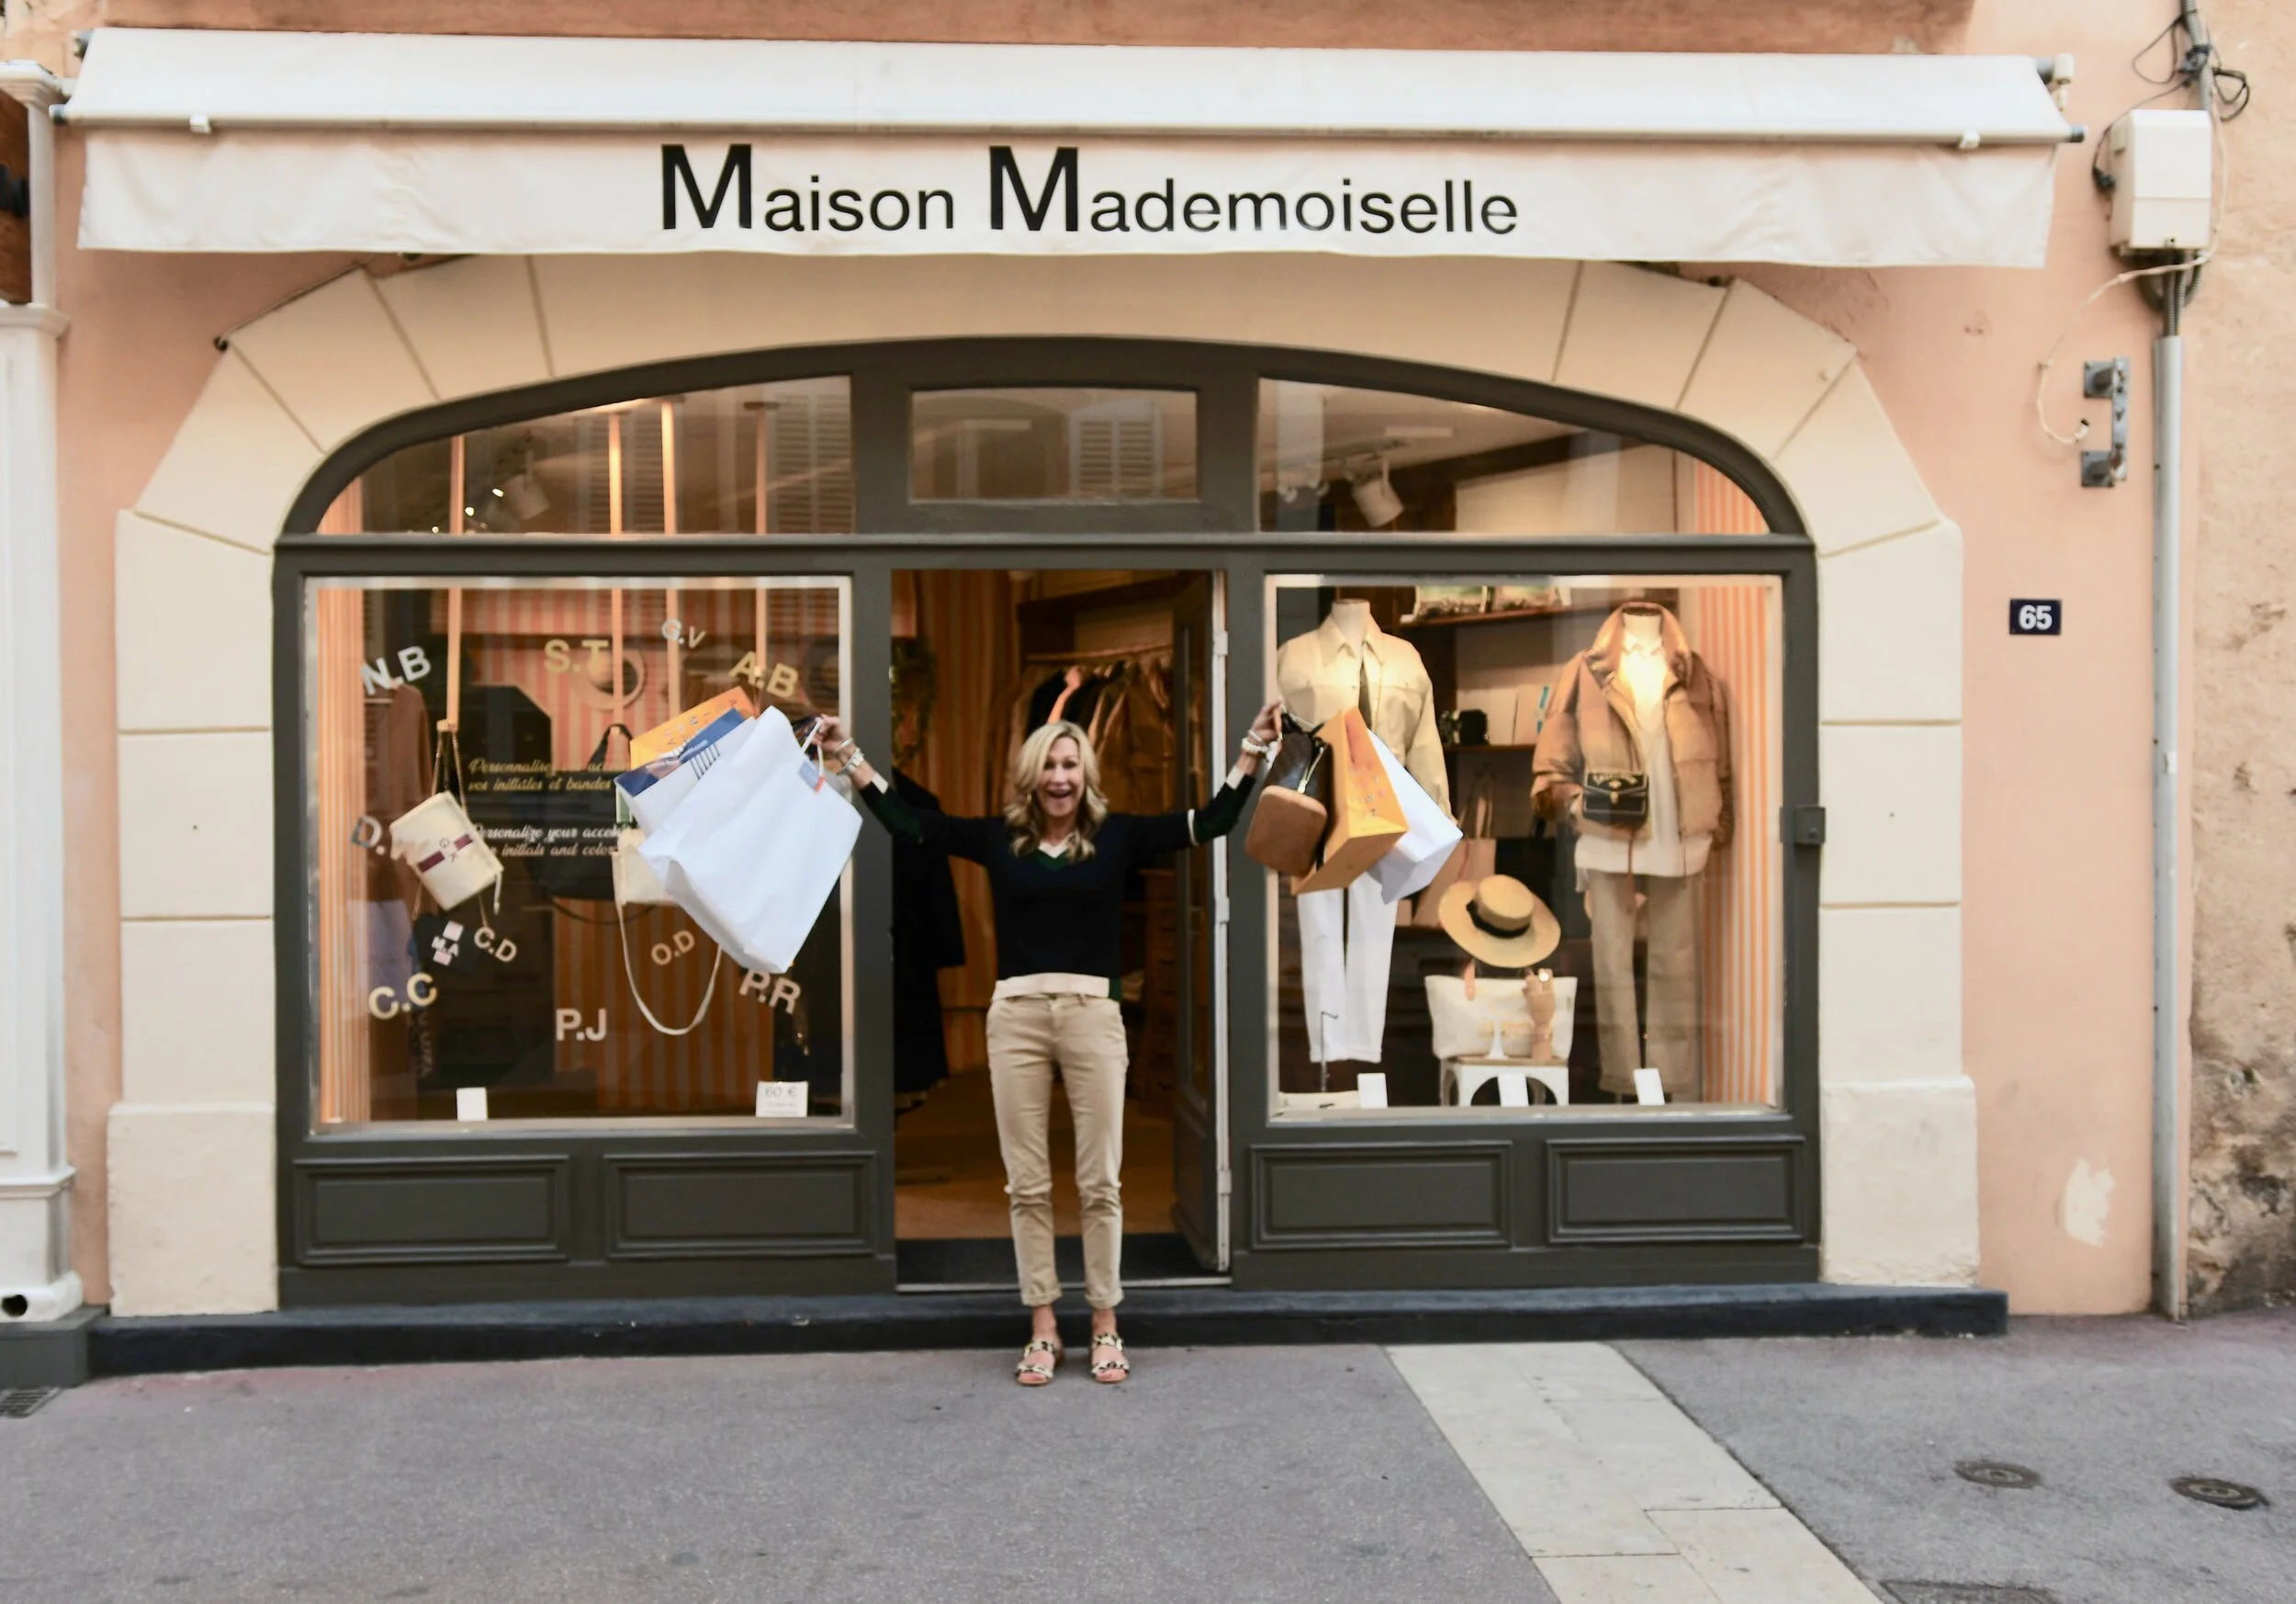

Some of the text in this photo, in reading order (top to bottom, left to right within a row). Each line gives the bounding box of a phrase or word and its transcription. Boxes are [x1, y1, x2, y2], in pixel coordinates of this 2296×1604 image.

[660, 143, 1518, 234] Maison Mademoiselle
[2019, 604, 2053, 630] 65
[360, 646, 432, 695] N.B
[544, 638, 609, 673] S.T
[728, 650, 799, 699] A.B
[474, 926, 517, 963] C.D
[651, 930, 695, 966] O.D
[368, 972, 437, 1020] C.C
[738, 968, 802, 1014] P.R
[556, 1008, 607, 1041] P.J
